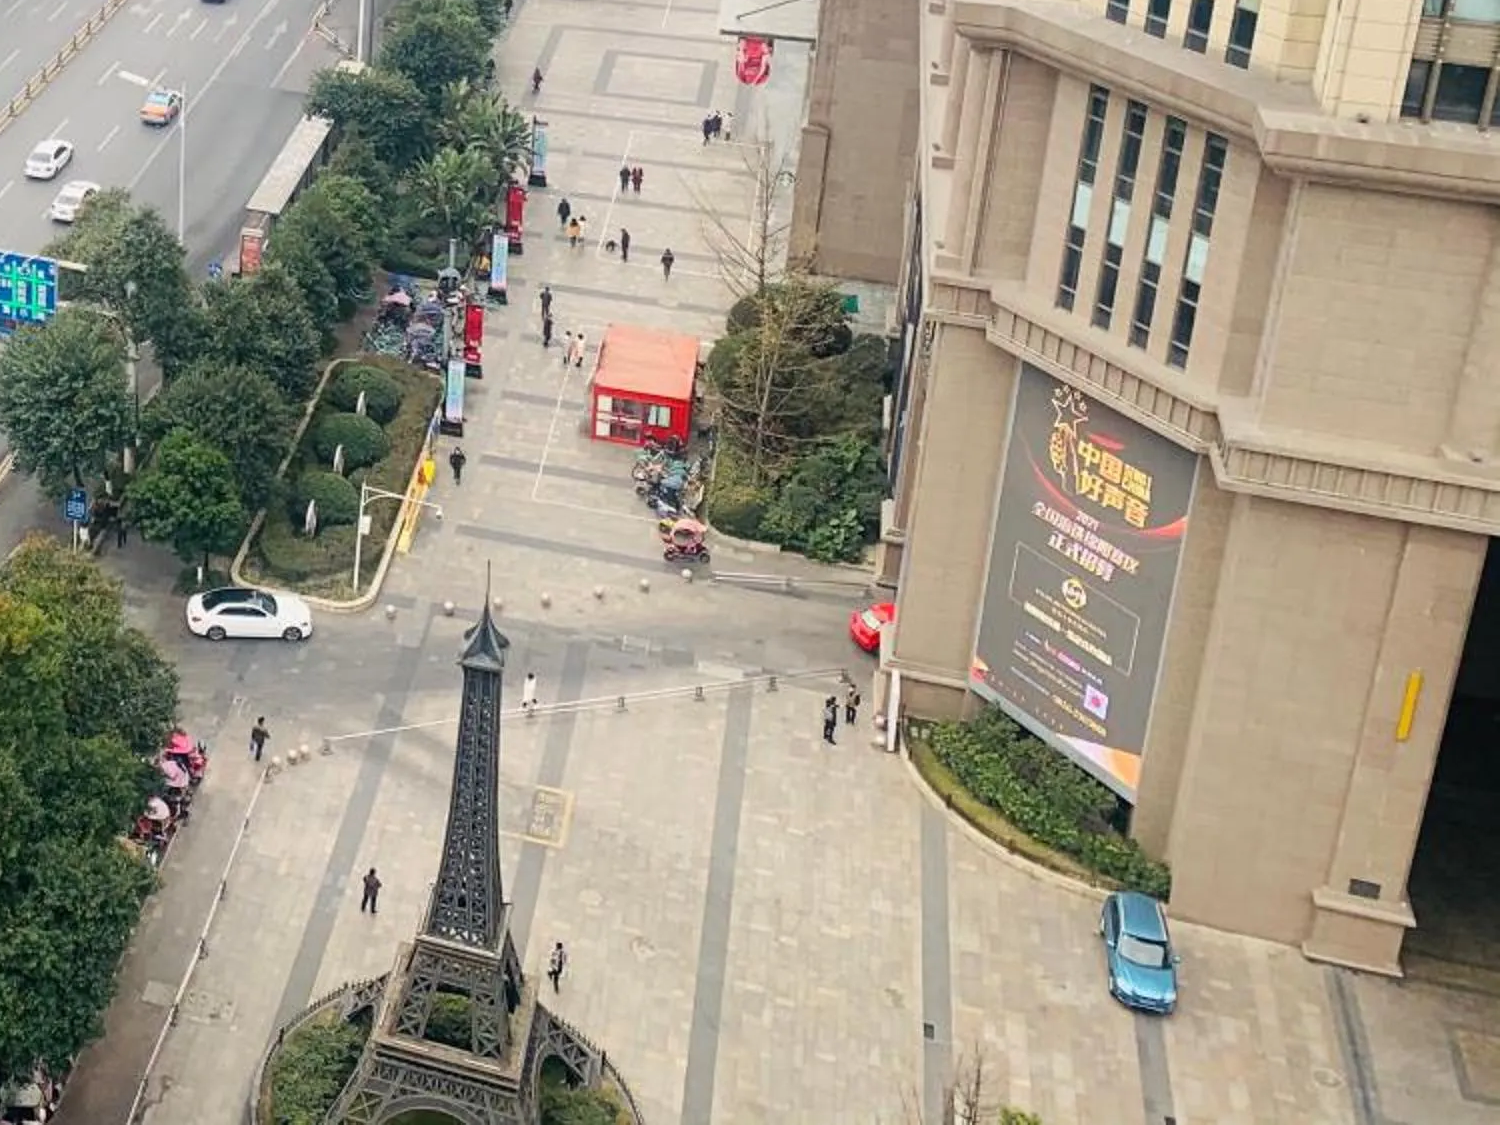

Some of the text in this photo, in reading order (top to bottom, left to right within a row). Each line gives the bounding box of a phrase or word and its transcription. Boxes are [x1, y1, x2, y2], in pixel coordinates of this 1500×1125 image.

[1077, 440, 1124, 484] 中国
[1076, 470, 1150, 528] 好声音
